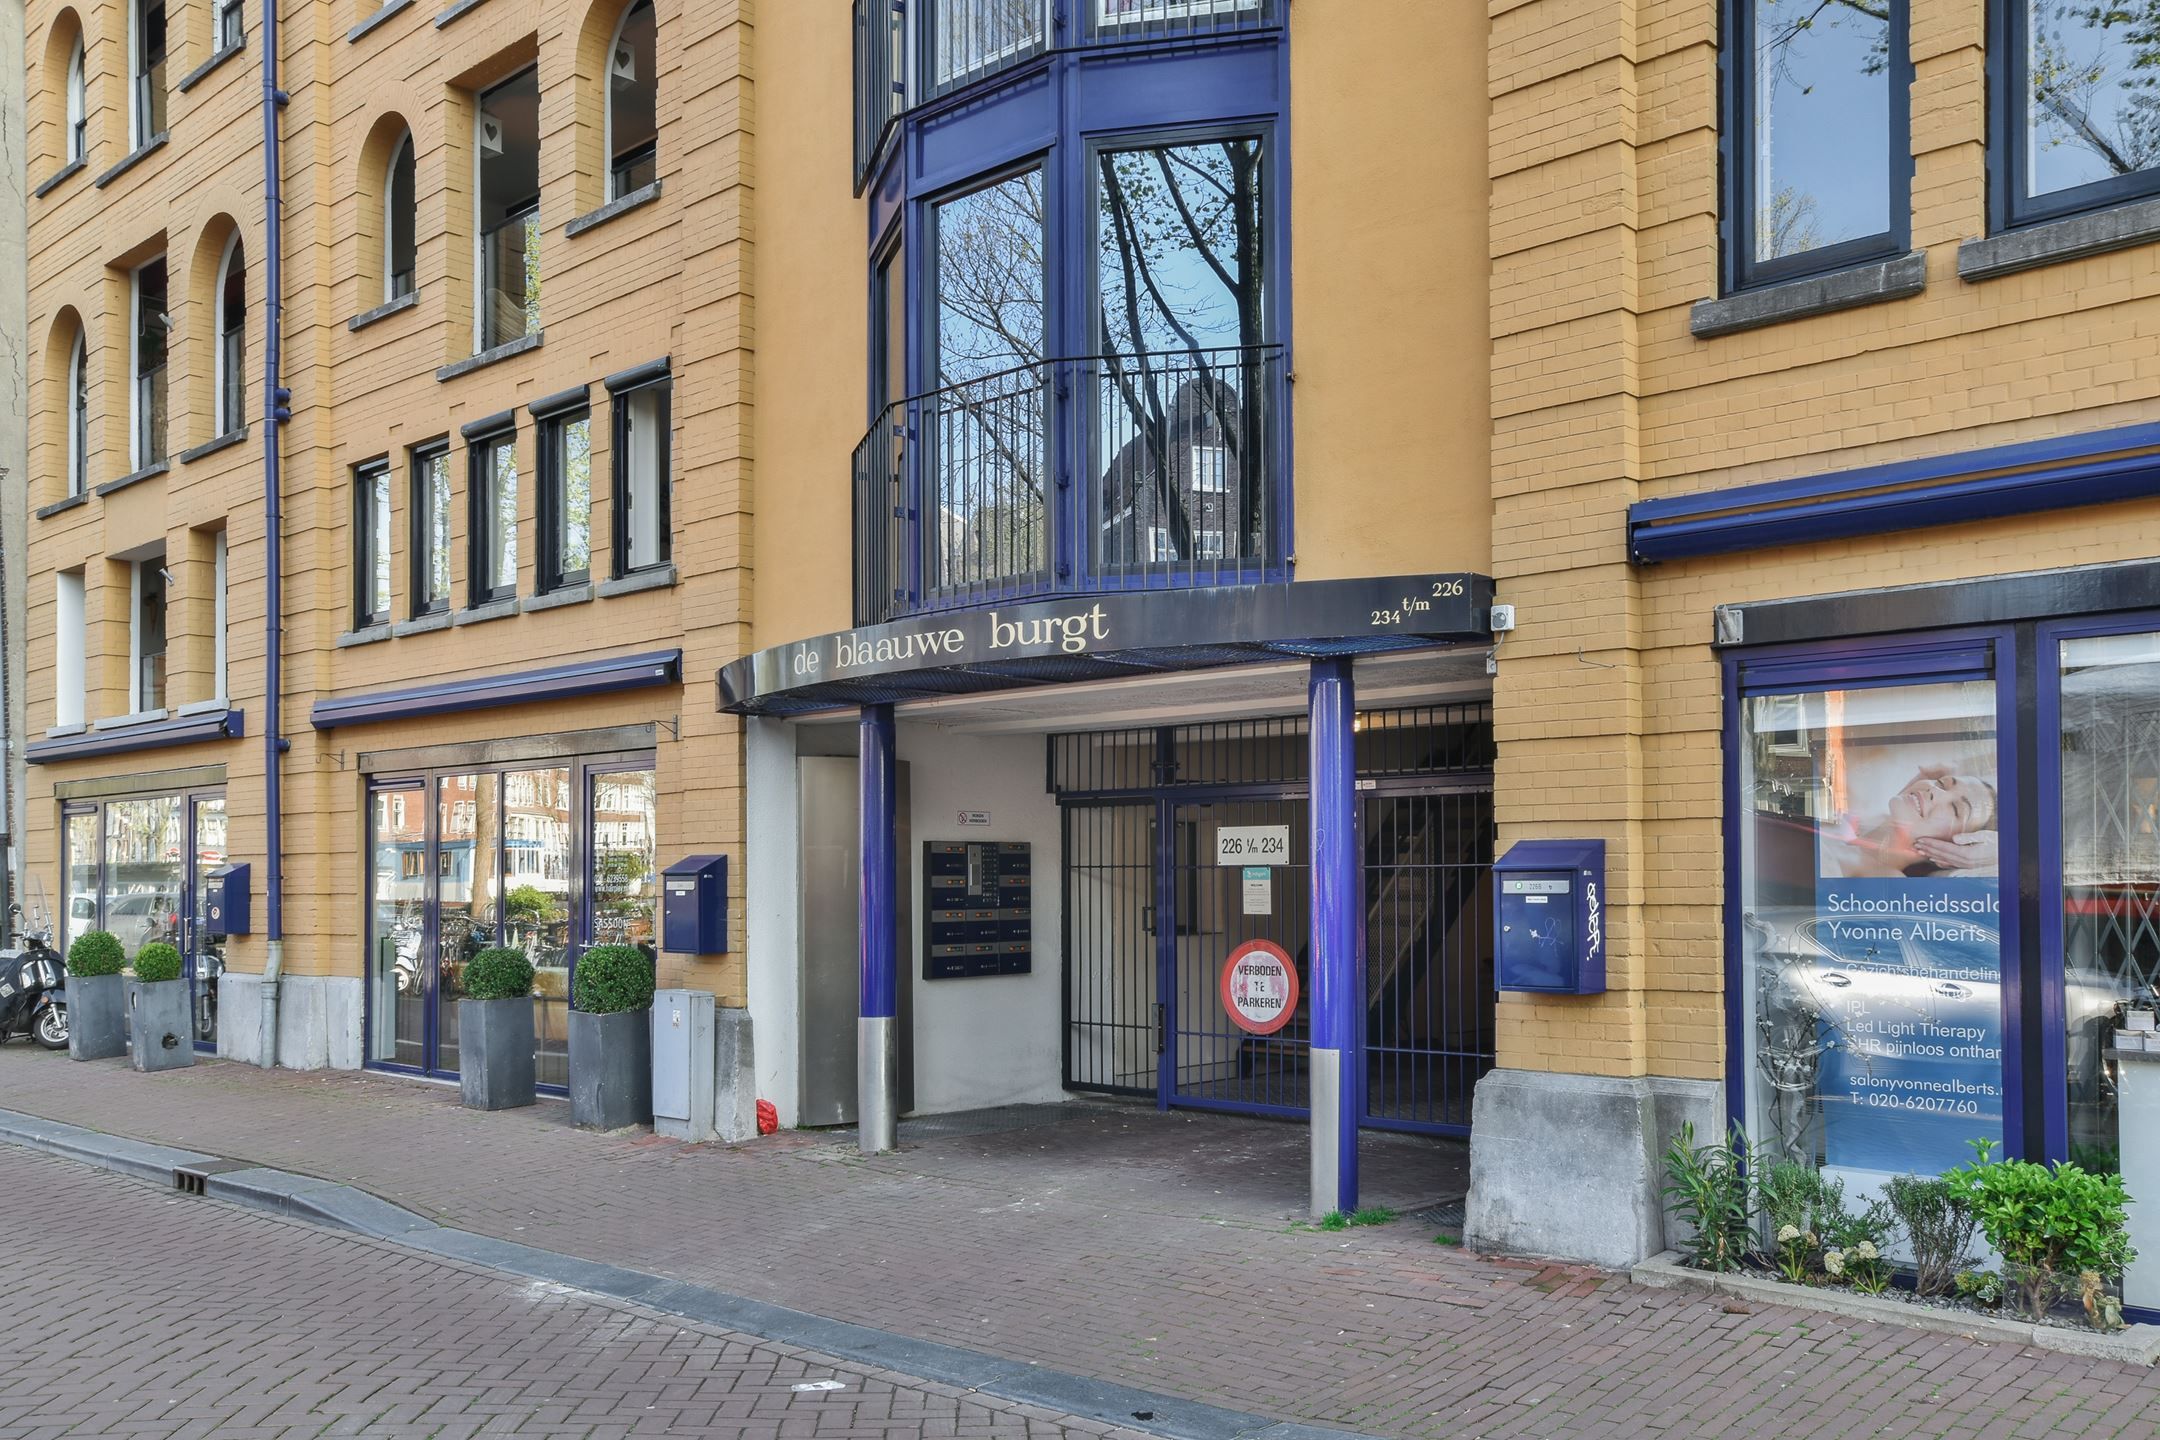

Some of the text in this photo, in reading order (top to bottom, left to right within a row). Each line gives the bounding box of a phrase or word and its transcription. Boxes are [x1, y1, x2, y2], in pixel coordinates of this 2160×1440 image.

[1371, 579, 1464, 625] 234 t/m 226
[794, 603, 1110, 675] de blaauwe burgt
[1222, 838, 1243, 854] 226
[1261, 837, 1284, 853] 234
[1828, 921, 1986, 942] Yvonne Alberts
[1238, 965, 1282, 977] VERBODEN
[1237, 996, 1282, 1009] PARKEREN
[1847, 1000, 1871, 1014] IPL
[1847, 1020, 1986, 1042] Led Light Therapy
[1886, 1040, 1945, 1057] pijnloos
[1850, 1073, 2002, 1096] salonyvonnealberts.
[1850, 1092, 1978, 1114] T: 020-6207760
